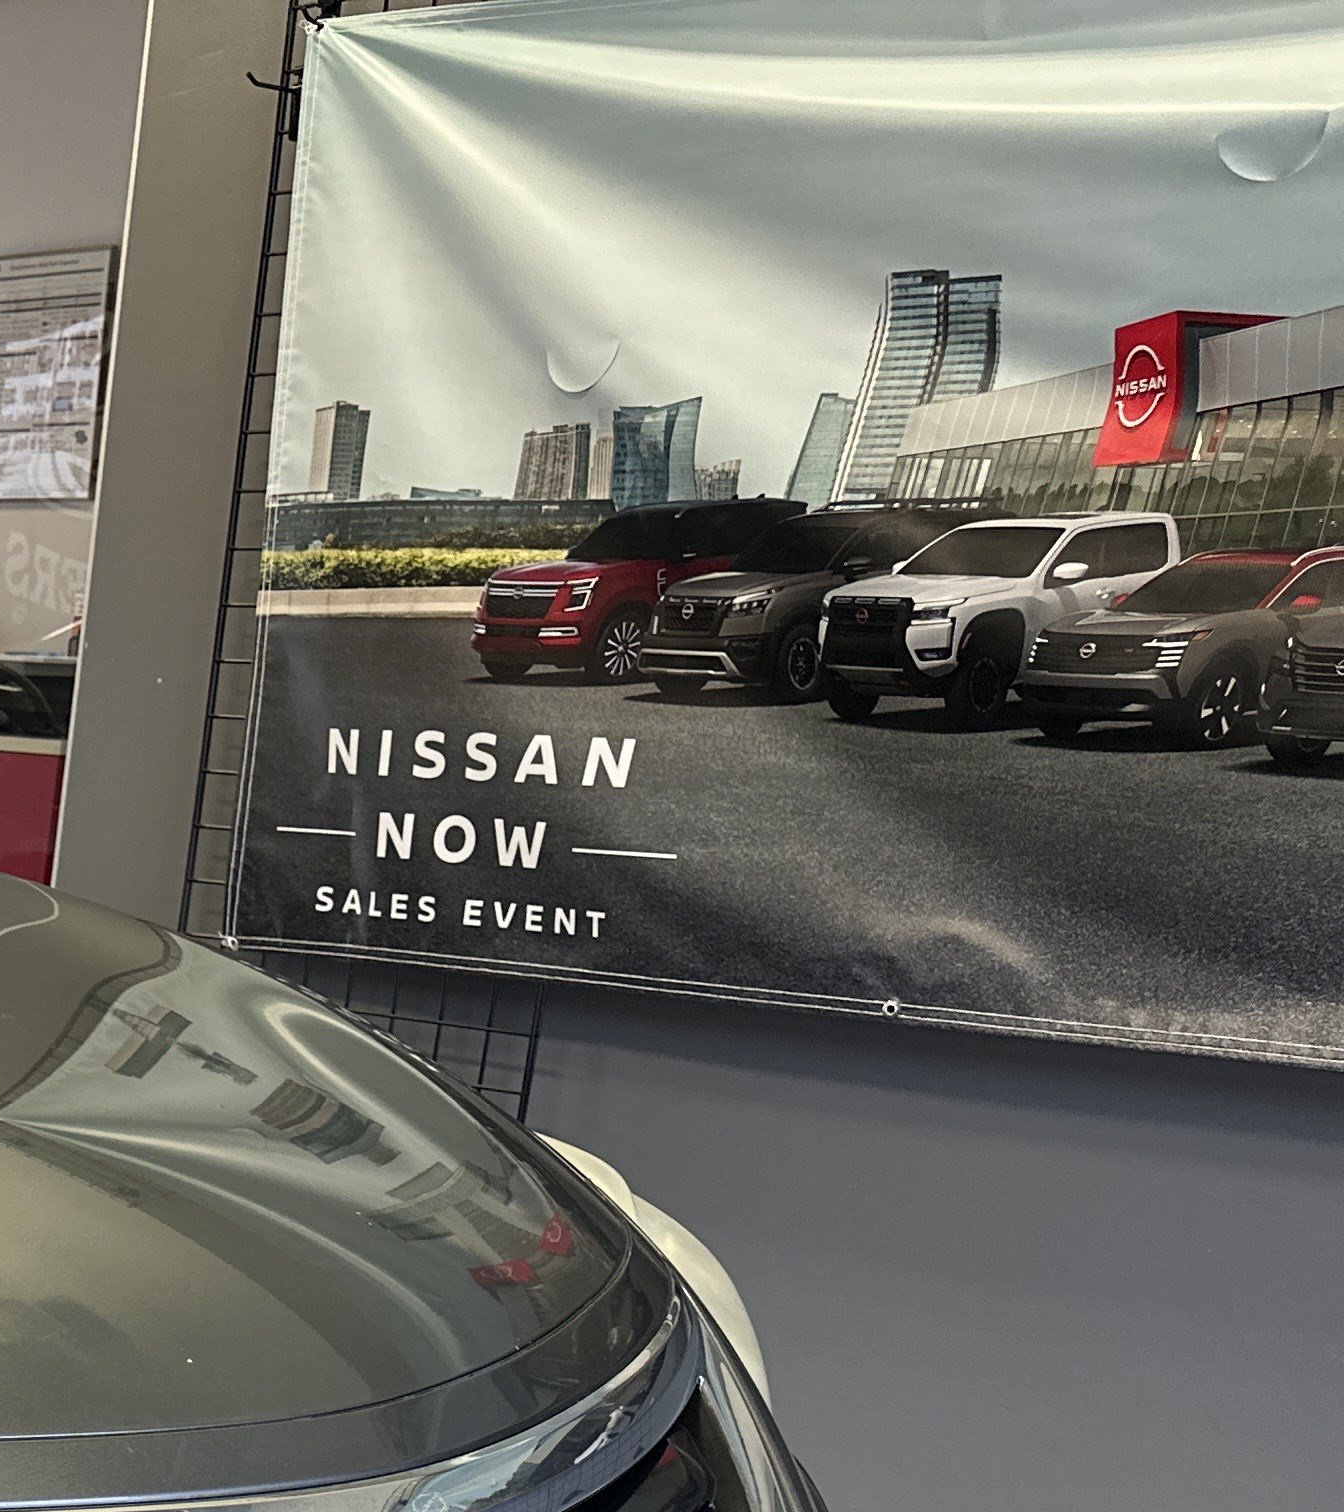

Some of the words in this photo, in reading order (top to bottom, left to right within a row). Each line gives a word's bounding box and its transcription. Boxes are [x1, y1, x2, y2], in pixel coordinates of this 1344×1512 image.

[1114, 373, 1168, 399] NISSAN
[326, 726, 637, 790] NISSAN
[375, 811, 547, 871] NOW
[314, 884, 438, 924] SALES
[462, 897, 608, 940] EVENT
